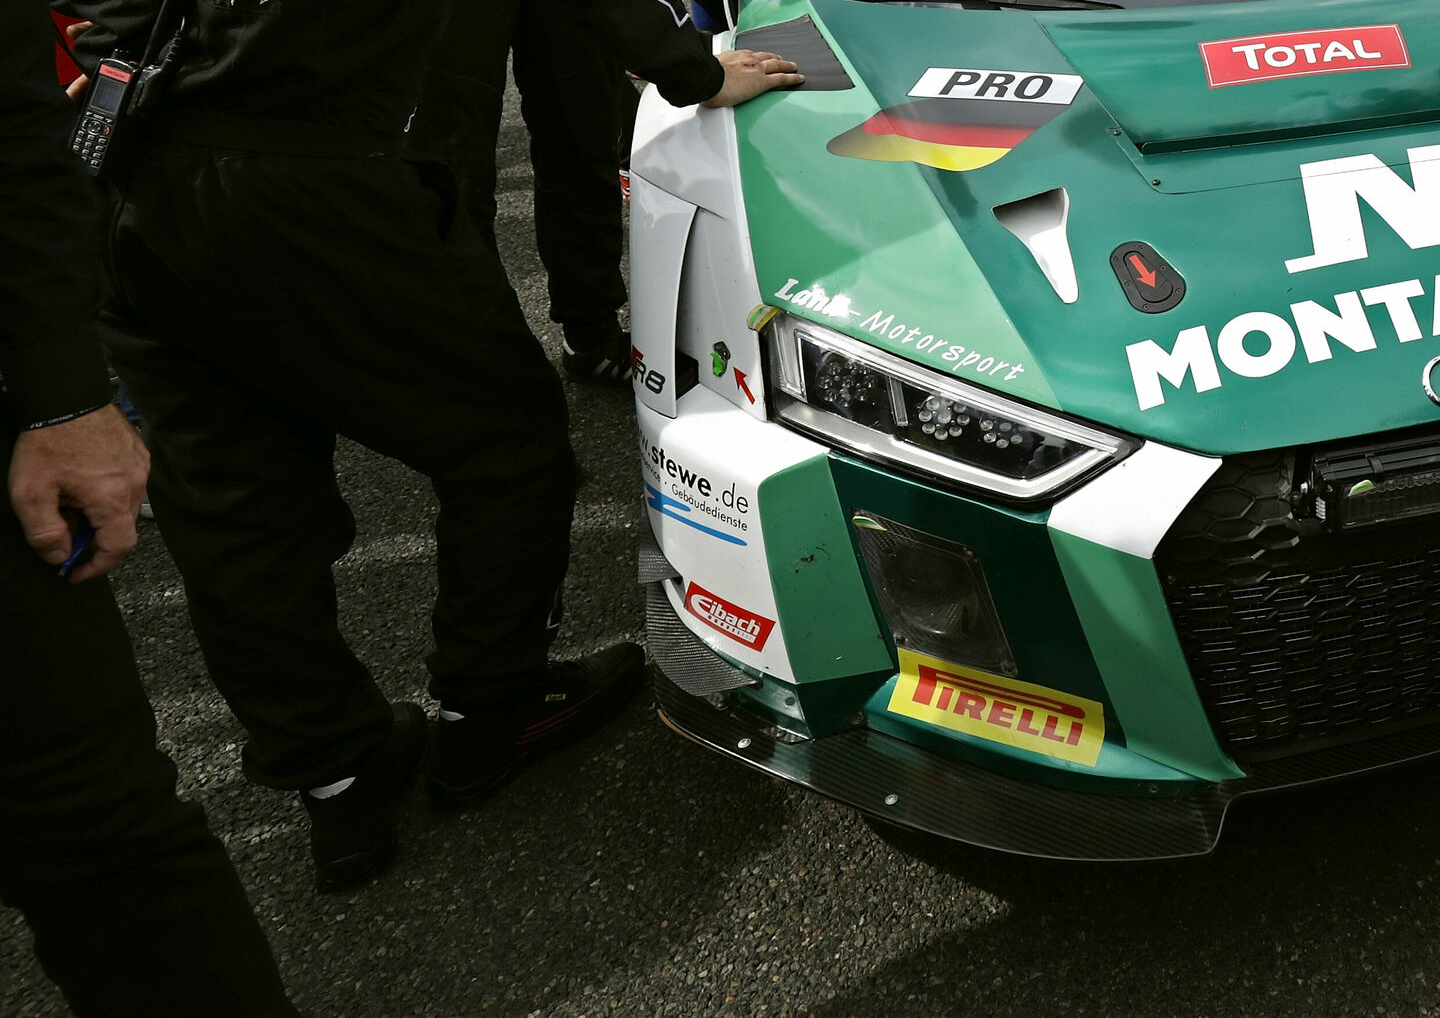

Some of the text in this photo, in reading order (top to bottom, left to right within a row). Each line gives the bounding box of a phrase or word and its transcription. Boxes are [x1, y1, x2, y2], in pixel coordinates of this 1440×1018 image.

[1232, 38, 1382, 70] TOTAL
[939, 70, 1055, 100] PRO
[671, 483, 748, 531] Gebäudedienste
[690, 593, 761, 641] Eibach
[911, 663, 1087, 747] PIRELLI
